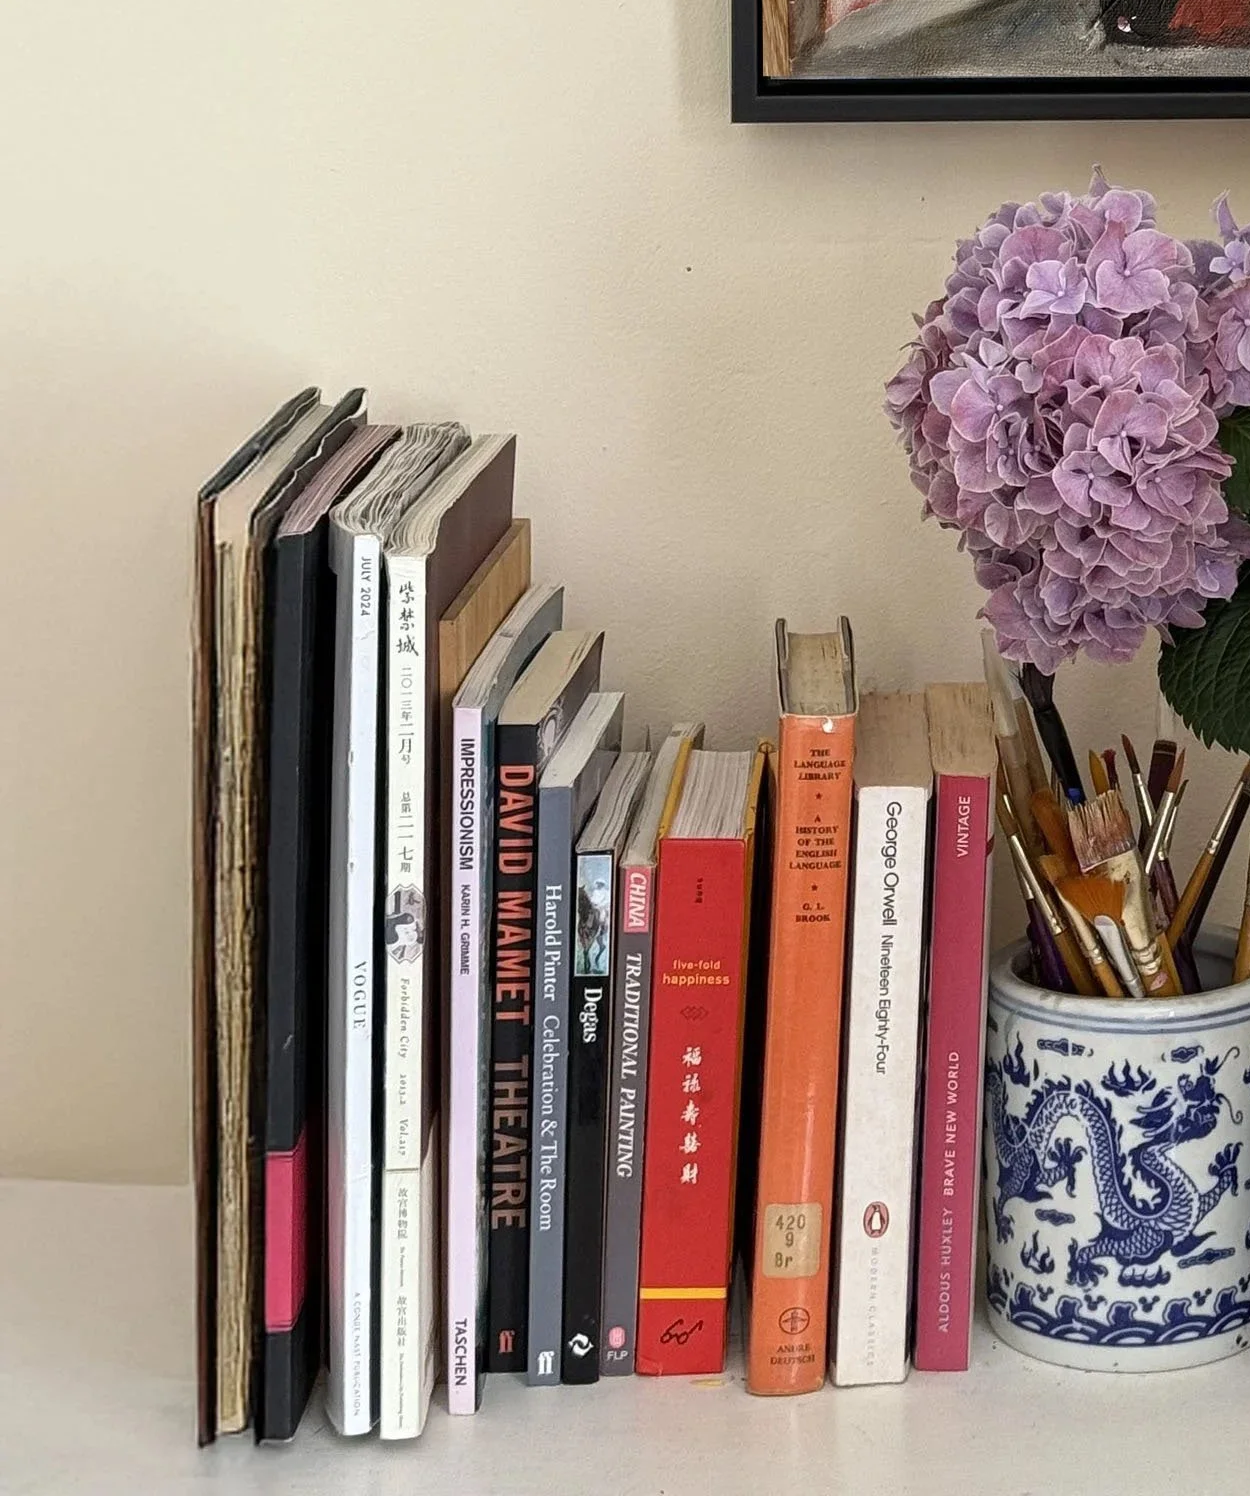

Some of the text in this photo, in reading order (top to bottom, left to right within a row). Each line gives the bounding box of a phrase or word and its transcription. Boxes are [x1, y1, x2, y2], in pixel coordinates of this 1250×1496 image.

[361, 557, 372, 616] JULY 2024
[810, 749, 830, 757] THE
[794, 760, 846, 768] LANGUAGE
[798, 772, 841, 780] LIBRARY
[459, 738, 475, 870] IMPRESSIONISM
[814, 815, 821, 823] A
[957, 796, 971, 857] VINTAGE
[795, 826, 839, 834] HISTORY
[797, 838, 835, 846] OF THE
[795, 849, 837, 858] ENGLISH
[789, 860, 842, 870] LANGUAGE
[795, 914, 831, 923] BROOK
[460, 884, 471, 975] KARIN H. GRIMME
[875, 801, 902, 1075] George Orwell Nineteen Eighty-Four
[673, 959, 721, 970] five-fold
[662, 972, 730, 986] happiness
[353, 961, 367, 1029] VOGUE
[491, 764, 535, 1230] DAVID MAMET THEATRE
[398, 977, 410, 1059] Forbidden City
[579, 987, 603, 1043] Degas
[616, 872, 647, 1179] CHINA TRADITIONAL PAINTING
[539, 884, 562, 1231] Harold Pinter Celebration & The Room
[938, 1051, 960, 1333] ALDOUS HUXLEY BRAVE NEW WORLD
[775, 1213, 806, 1231] 420
[785, 1231, 794, 1248] 9
[454, 1317, 468, 1386] TASCHEN
[606, 1350, 629, 1361] FLP
